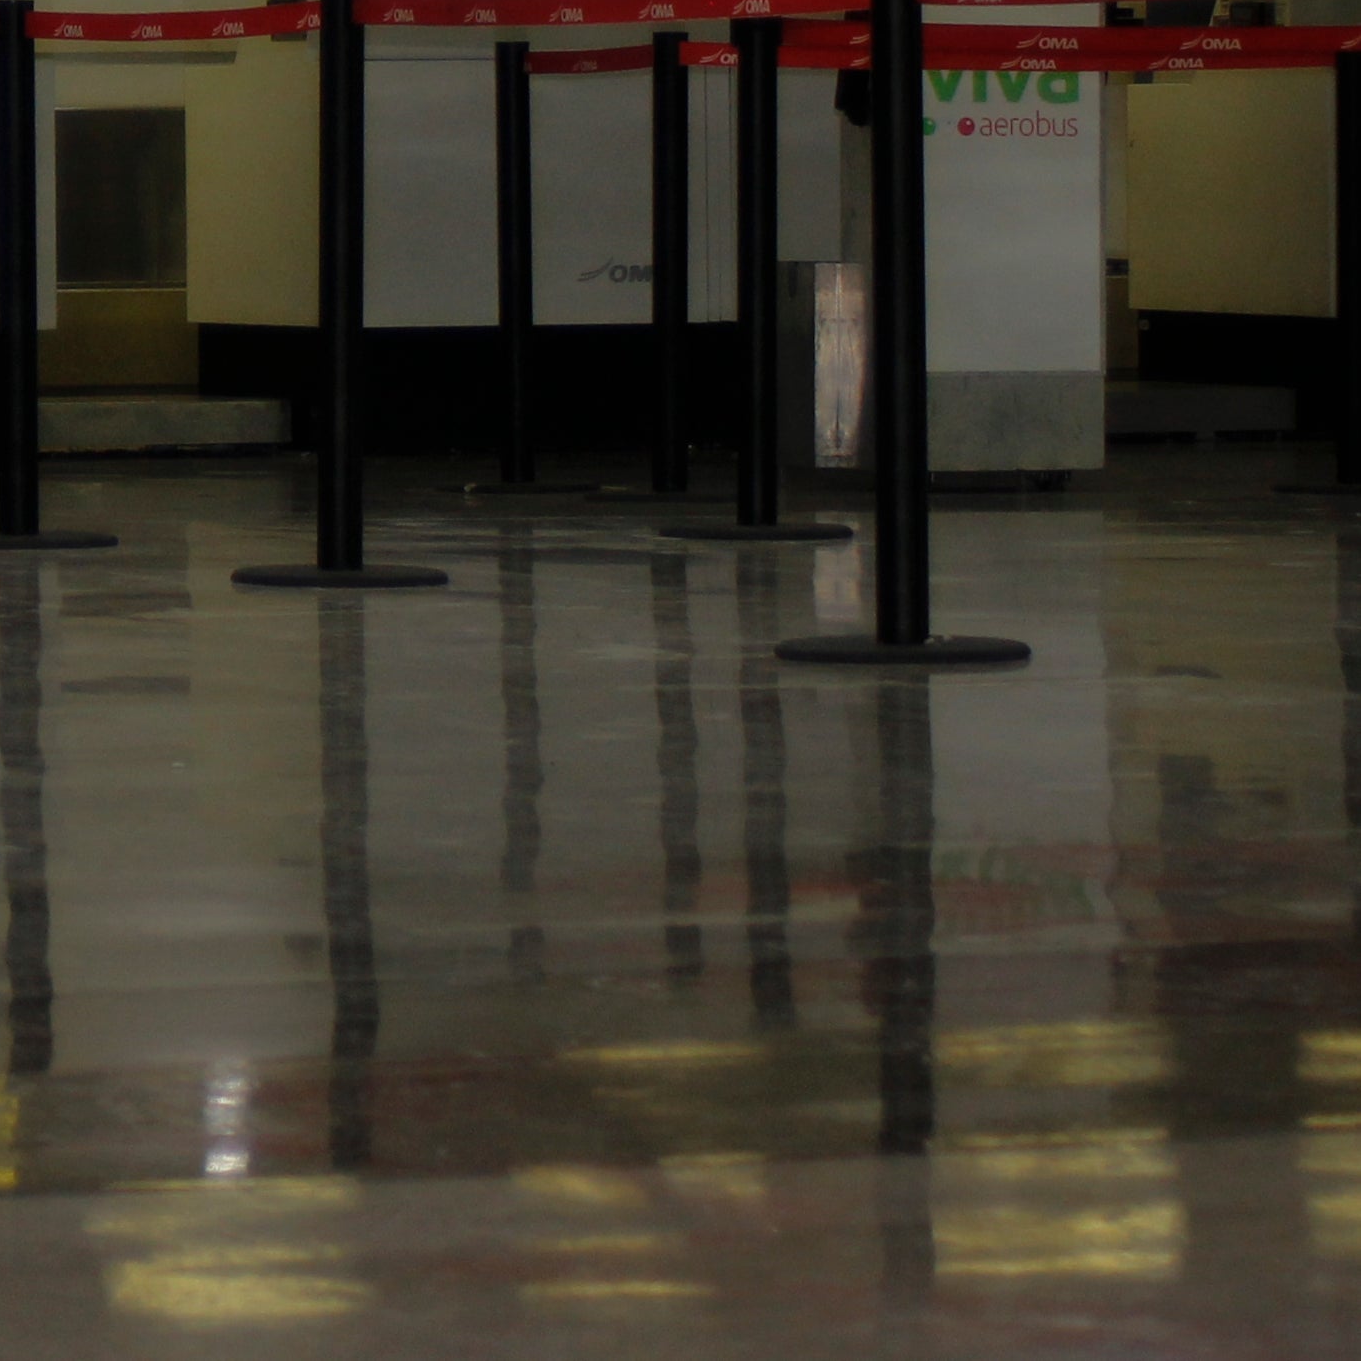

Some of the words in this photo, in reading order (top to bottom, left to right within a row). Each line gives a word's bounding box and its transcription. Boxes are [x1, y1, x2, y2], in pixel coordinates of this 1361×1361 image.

[1038, 37, 1079, 50] OMA
[1201, 37, 1242, 50] OMA
[1020, 58, 1057, 70] OMA
[1168, 57, 1204, 69] OMA
[980, 110, 1077, 137] aerobus
[609, 264, 653, 283] OM
